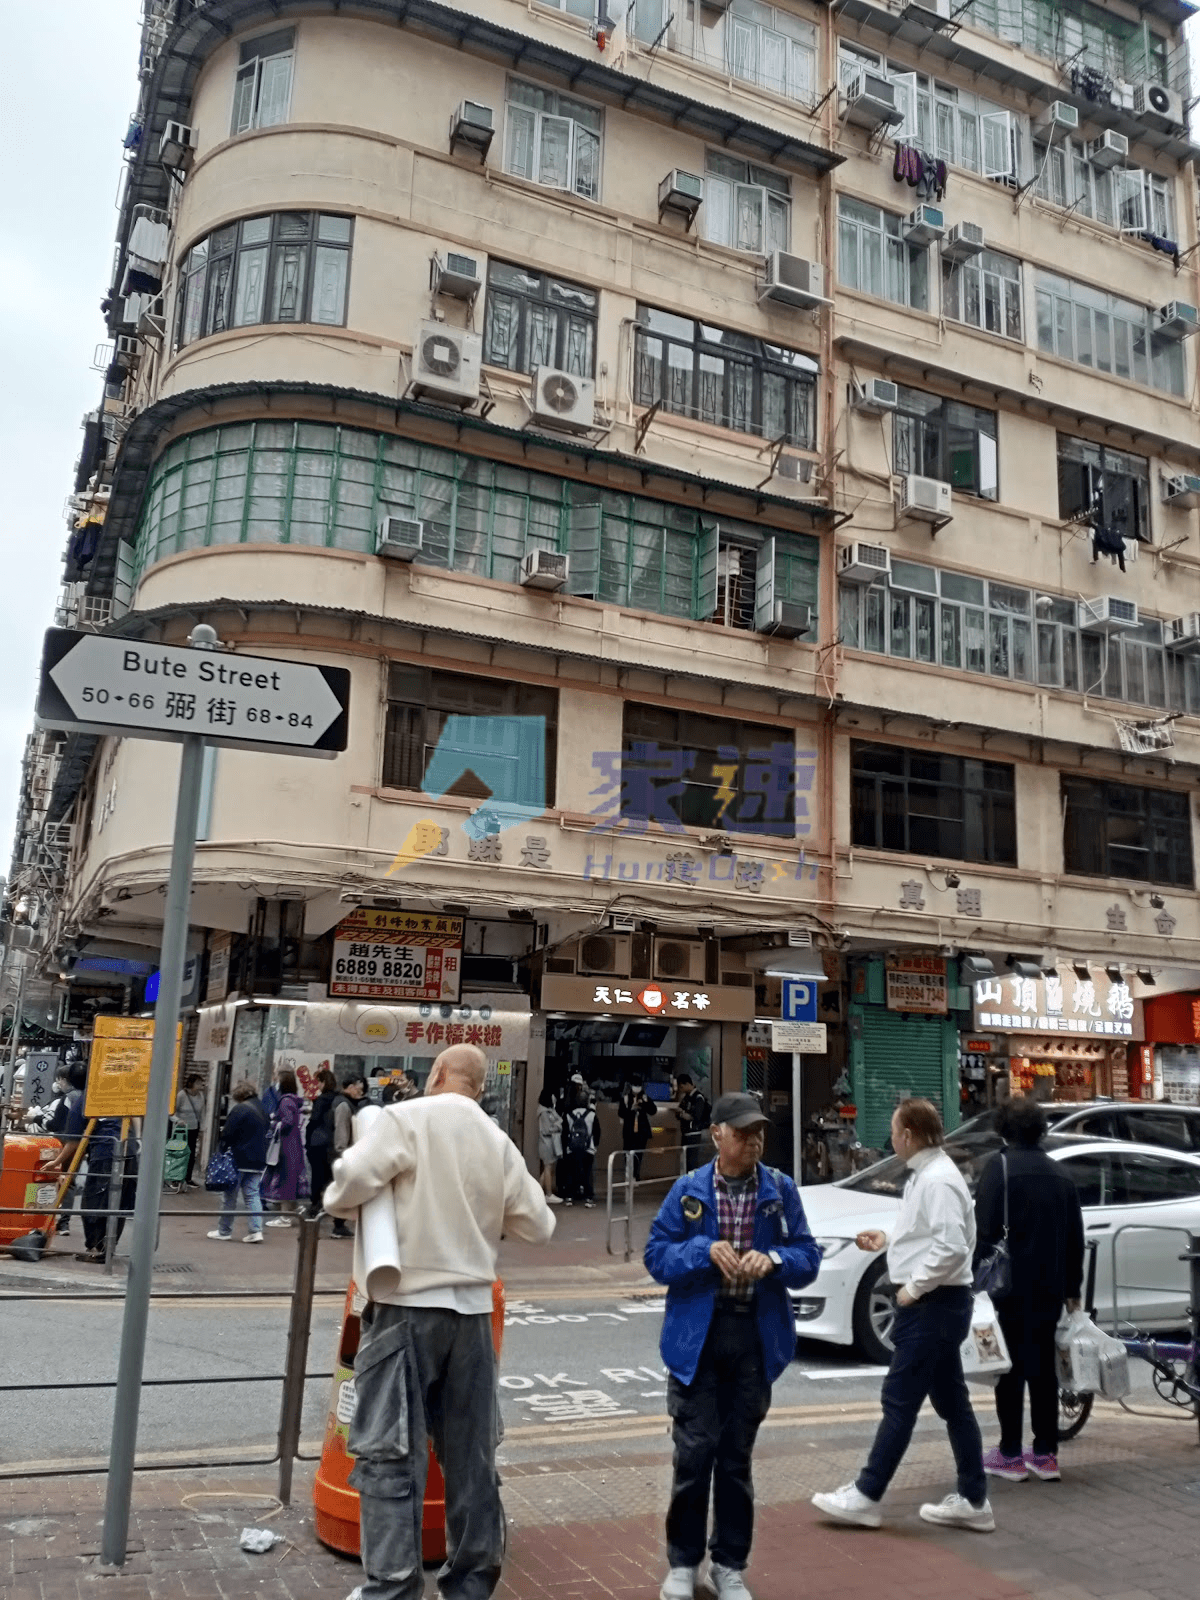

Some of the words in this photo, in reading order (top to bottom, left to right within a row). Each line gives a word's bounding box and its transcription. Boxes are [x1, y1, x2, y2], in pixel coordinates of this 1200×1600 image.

[122, 650, 187, 678] Bute
[198, 661, 281, 691] Street
[165, 691, 237, 726] 弼街
[900, 879, 982, 917] 真理
[349, 943, 414, 961] 趙先生
[444, 956, 458, 972] 租
[335, 958, 377, 976] 6889
[383, 961, 423, 979] 8820
[593, 986, 633, 1005] 天仁
[671, 991, 711, 1010] 茗茶
[789, 983, 810, 1018] P
[405, 1022, 502, 1046] 手作糯米糍
[498, 1373, 589, 1389] OK
